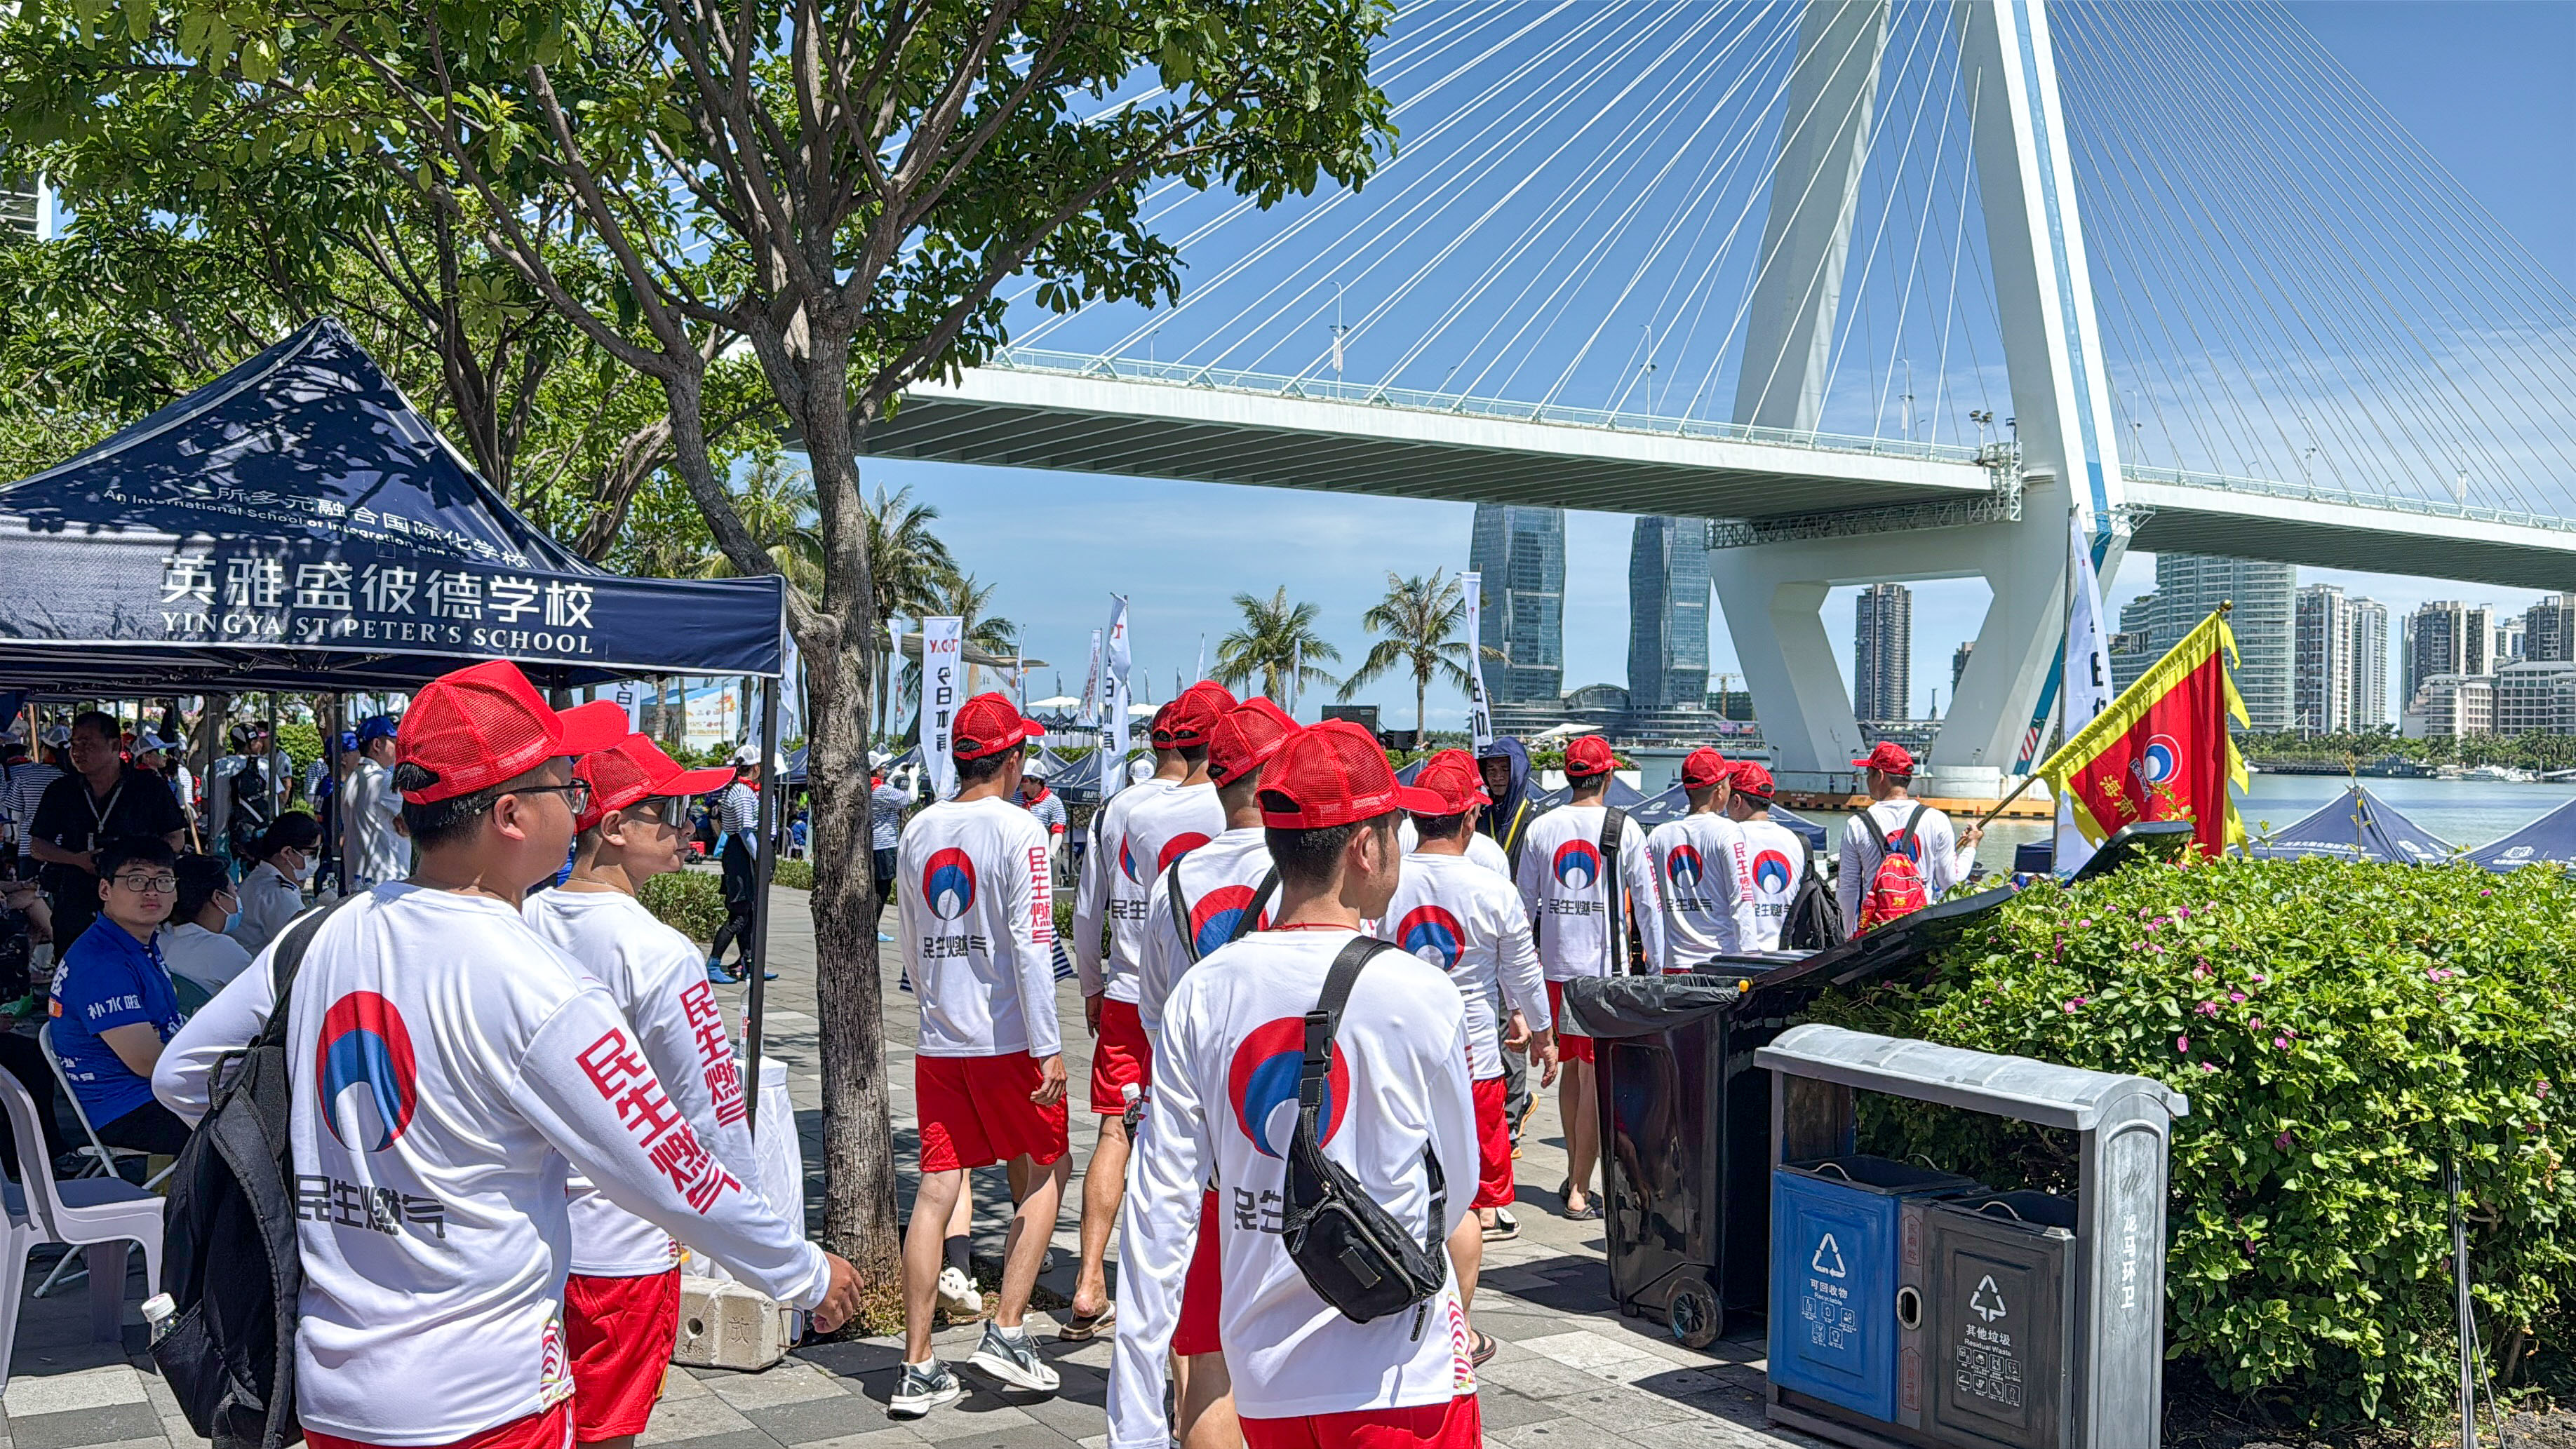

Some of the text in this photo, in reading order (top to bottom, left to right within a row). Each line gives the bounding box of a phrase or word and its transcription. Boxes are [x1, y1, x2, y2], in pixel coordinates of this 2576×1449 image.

[104, 489, 127, 504] An
[246, 508, 303, 525] School
[327, 520, 414, 548] Integration
[159, 553, 595, 629] 英雅盛彼德学校
[161, 612, 593, 654] YINGYA ST PETER'S SCHOOL
[1028, 846, 1054, 954] 民生燃气
[1548, 898, 1605, 917] 民生燃气
[923, 934, 988, 959] 民生燃气
[86, 994, 142, 1020] 补水啦
[678, 978, 750, 1130] 民生燃气
[575, 1026, 742, 1216] 民生燃气
[295, 1173, 446, 1239] 民生燃气
[2120, 1213, 2138, 1309] 龙马环卫
[1809, 1278, 1849, 1299] 可回收物
[1964, 1337, 2012, 1356] Residual Waste
[1966, 1323, 2011, 1347] 其他垃圾
